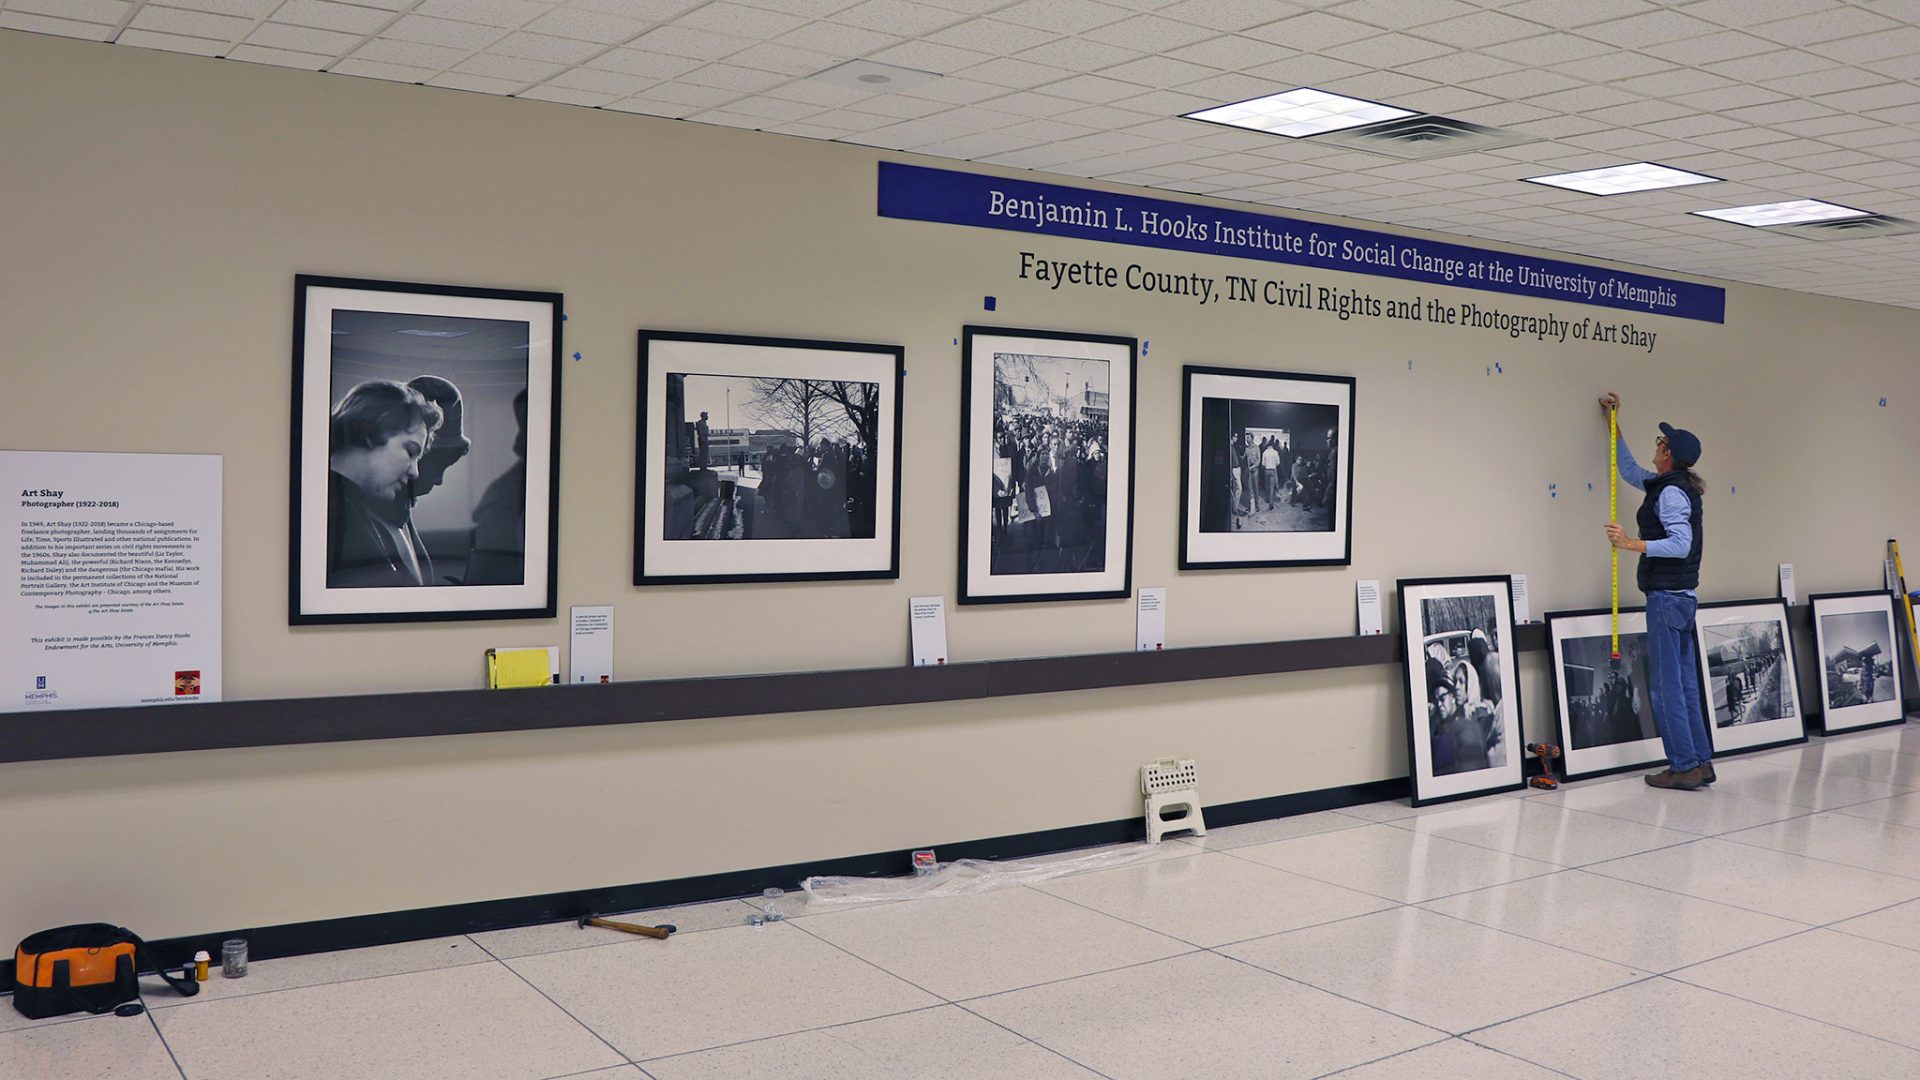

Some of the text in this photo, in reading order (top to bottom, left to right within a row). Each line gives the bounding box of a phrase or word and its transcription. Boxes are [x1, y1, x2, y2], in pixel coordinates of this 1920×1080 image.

[988, 191, 1677, 309] Benjamin L. Hooks Institute for Social Change at the University of Memphis
[1019, 251, 1657, 354] Fayette County, TN Civil Rights and the Photography of Art Shay
[22, 500, 74, 508] Photographer
[40, 489, 64, 499] Shay
